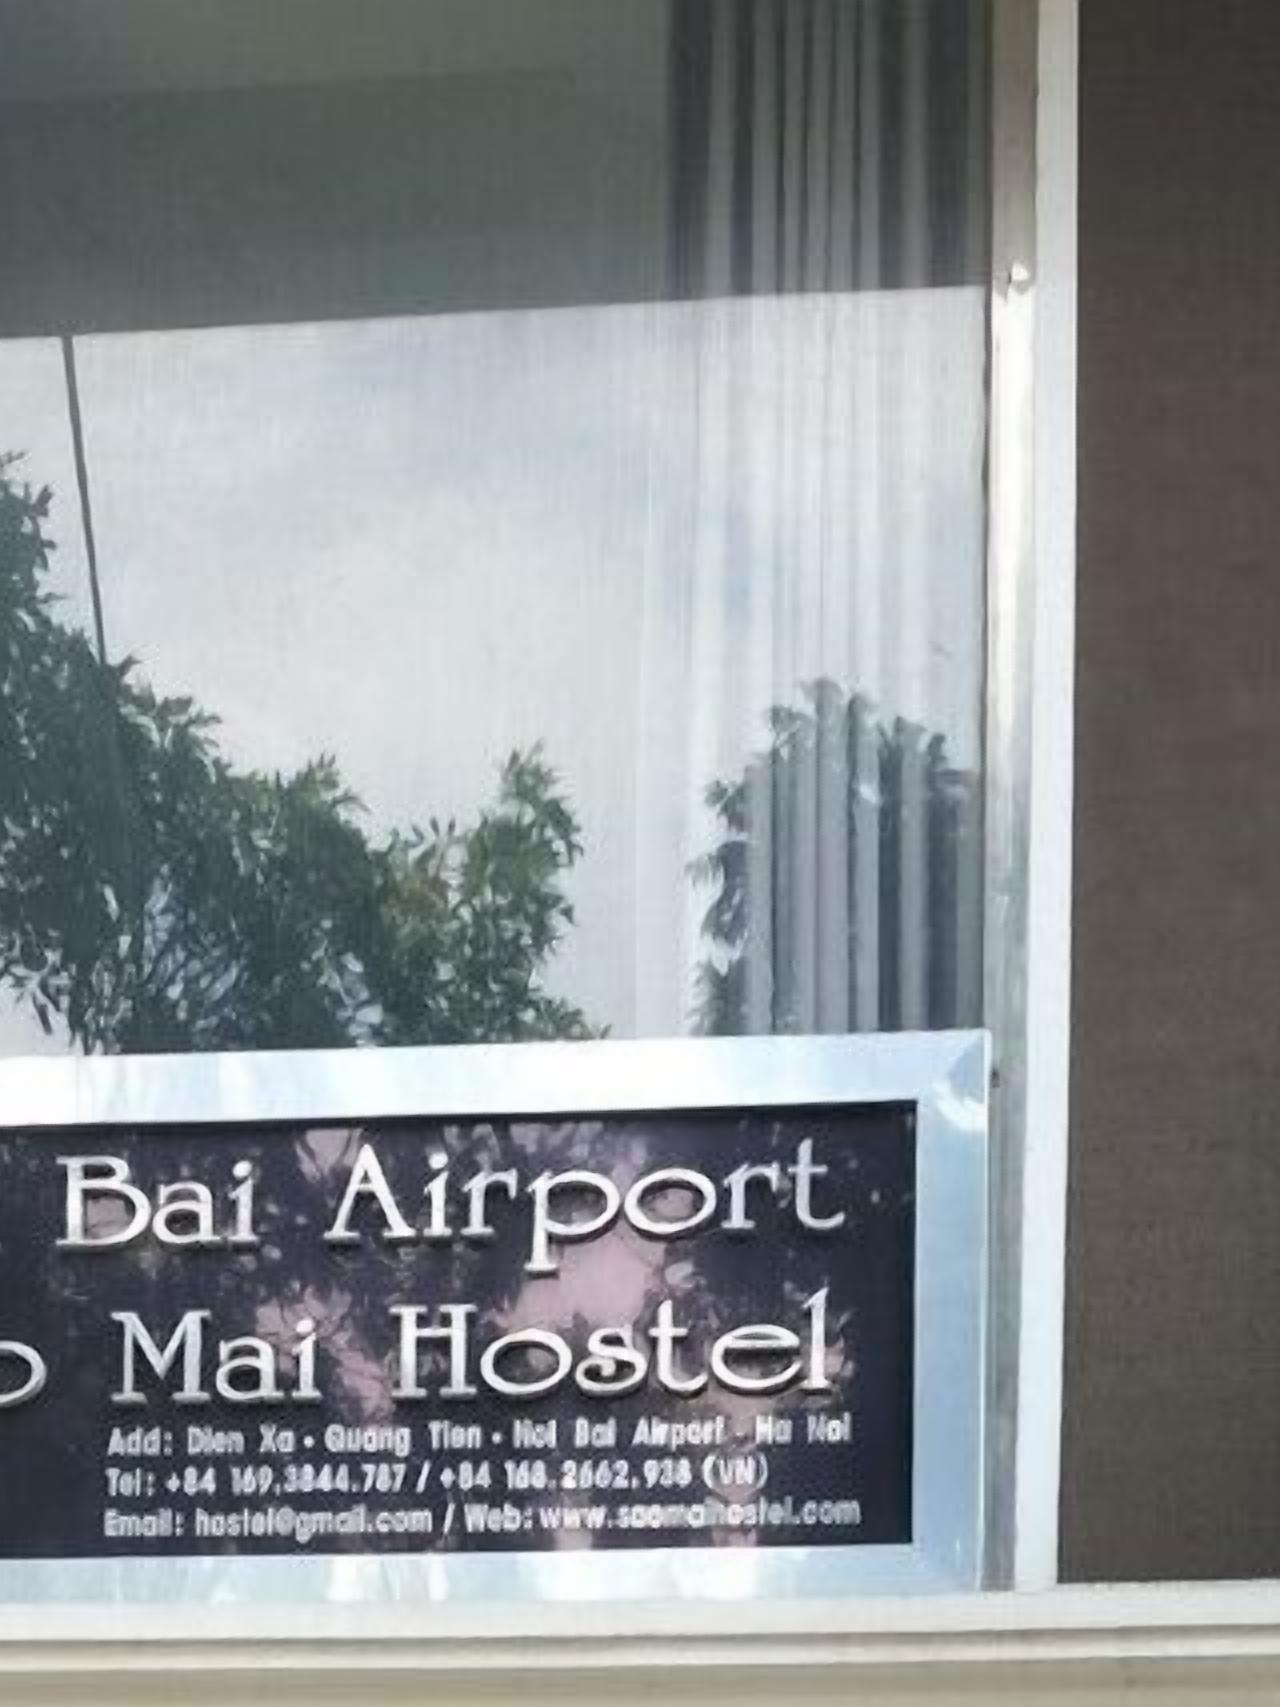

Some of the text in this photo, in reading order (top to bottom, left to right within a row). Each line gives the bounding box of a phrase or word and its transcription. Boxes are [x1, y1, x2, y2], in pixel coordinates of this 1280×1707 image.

[55, 1155, 261, 1248] Bai
[323, 1137, 845, 1275] Airport
[110, 1309, 323, 1404] Mai
[388, 1286, 834, 1399] Hostel
[107, 1426, 173, 1457] Add:
[258, 1423, 296, 1453] Xa
[574, 1416, 617, 1449] Bai
[631, 1414, 725, 1452] Airport
[105, 1466, 156, 1497] Tel:
[104, 1507, 184, 1538] Email:
